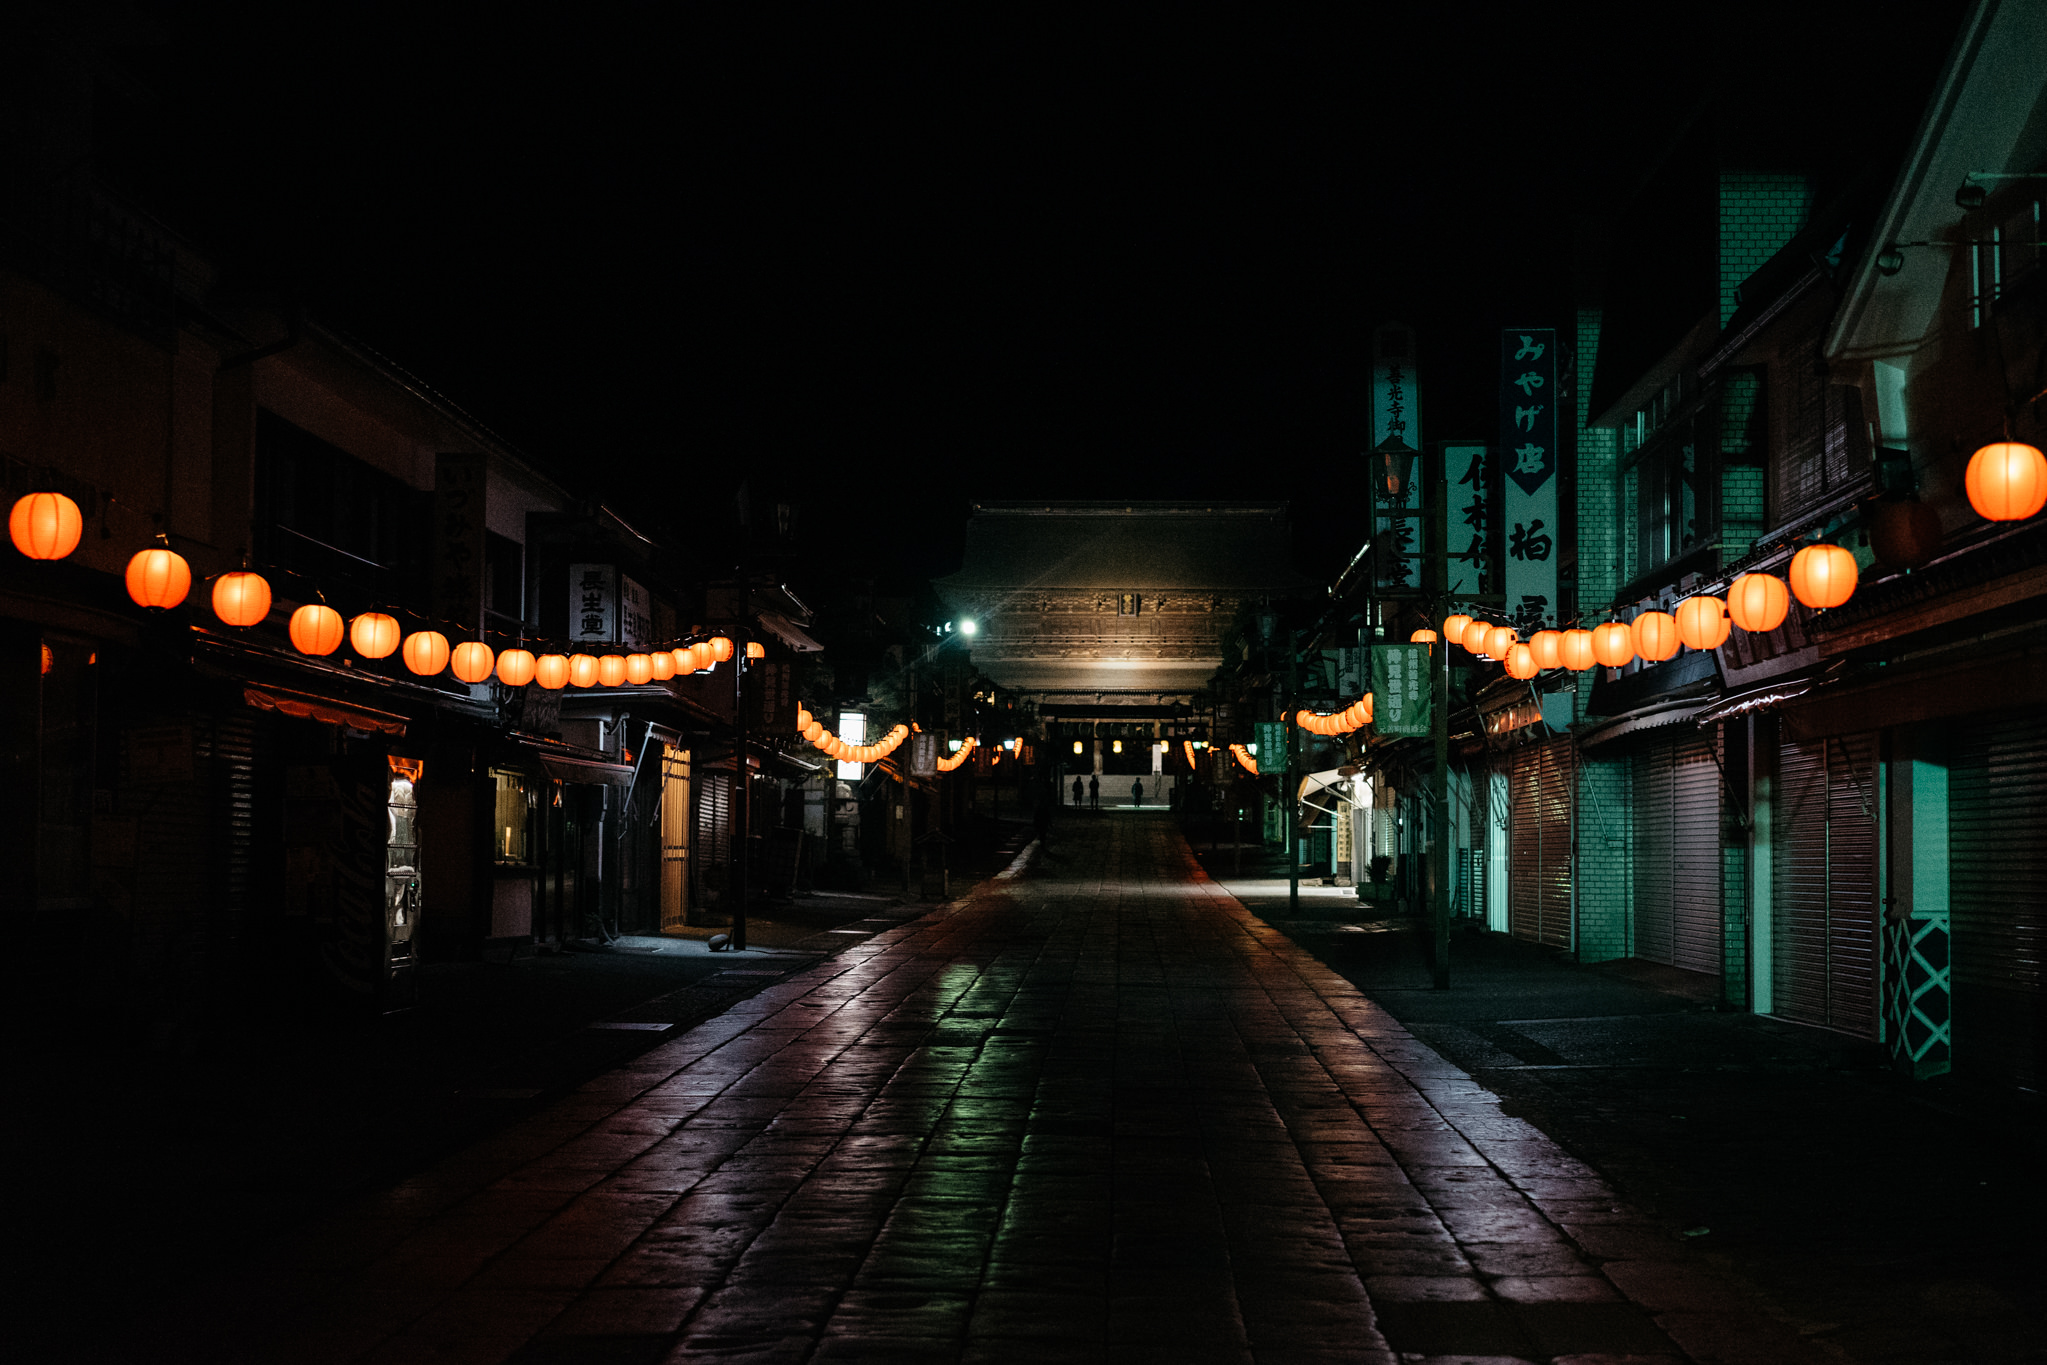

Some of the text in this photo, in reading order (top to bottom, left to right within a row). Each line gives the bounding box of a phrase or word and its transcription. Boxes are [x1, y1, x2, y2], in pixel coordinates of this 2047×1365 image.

[1512, 334, 1546, 475] みやげ店
[580, 571, 606, 635] 長生堂
